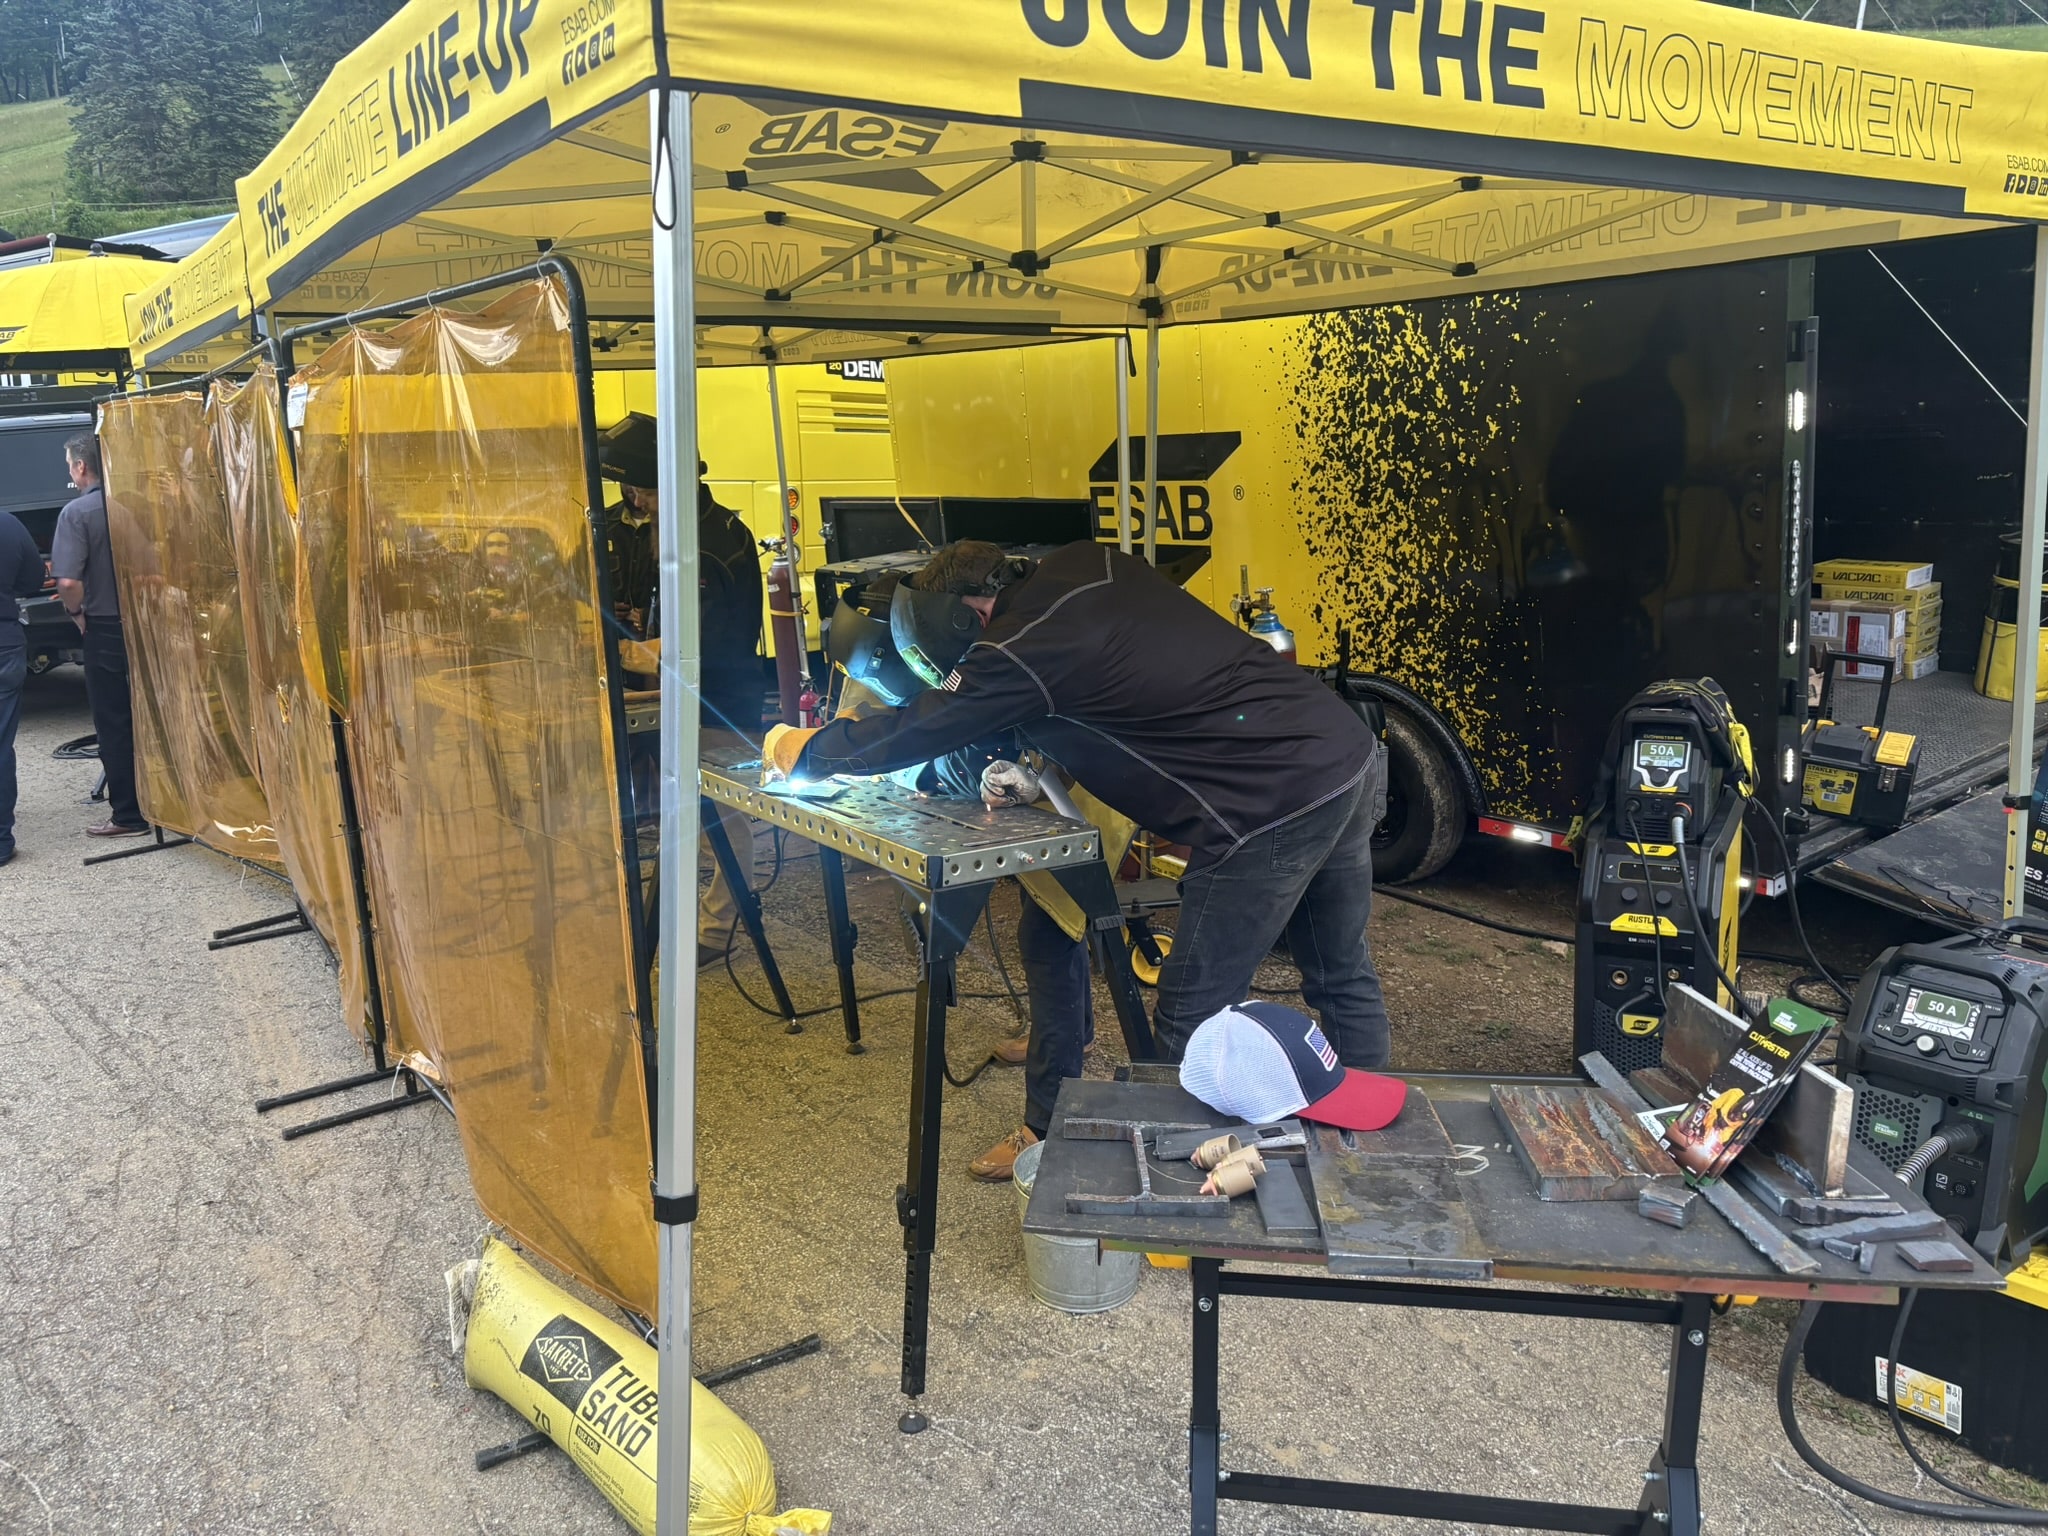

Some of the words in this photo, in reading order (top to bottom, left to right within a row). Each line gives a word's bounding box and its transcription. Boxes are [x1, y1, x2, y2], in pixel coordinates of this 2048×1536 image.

[561, 0, 616, 46] ESAB.COM
[1352, 0, 1546, 109] THE
[1575, 17, 1974, 164] MOVEMENT
[257, 179, 290, 258] THE
[285, 79, 388, 236] ULTIMATE
[388, 0, 539, 159] LINE-UP
[155, 285, 173, 334] THE
[173, 239, 233, 324] MOVEMENT
[1089, 485, 1214, 541] ESAB
[1832, 571, 1882, 583] VACPAC
[1844, 590, 1894, 602] VACPAC
[1649, 745, 1675, 756] 50A
[1628, 915, 1663, 926] RUSTLR
[1927, 1000, 1944, 1014] 50
[1945, 1005, 1957, 1018] A
[540, 1337, 591, 1380] SAKRETE
[581, 1390, 653, 1458] SAND
